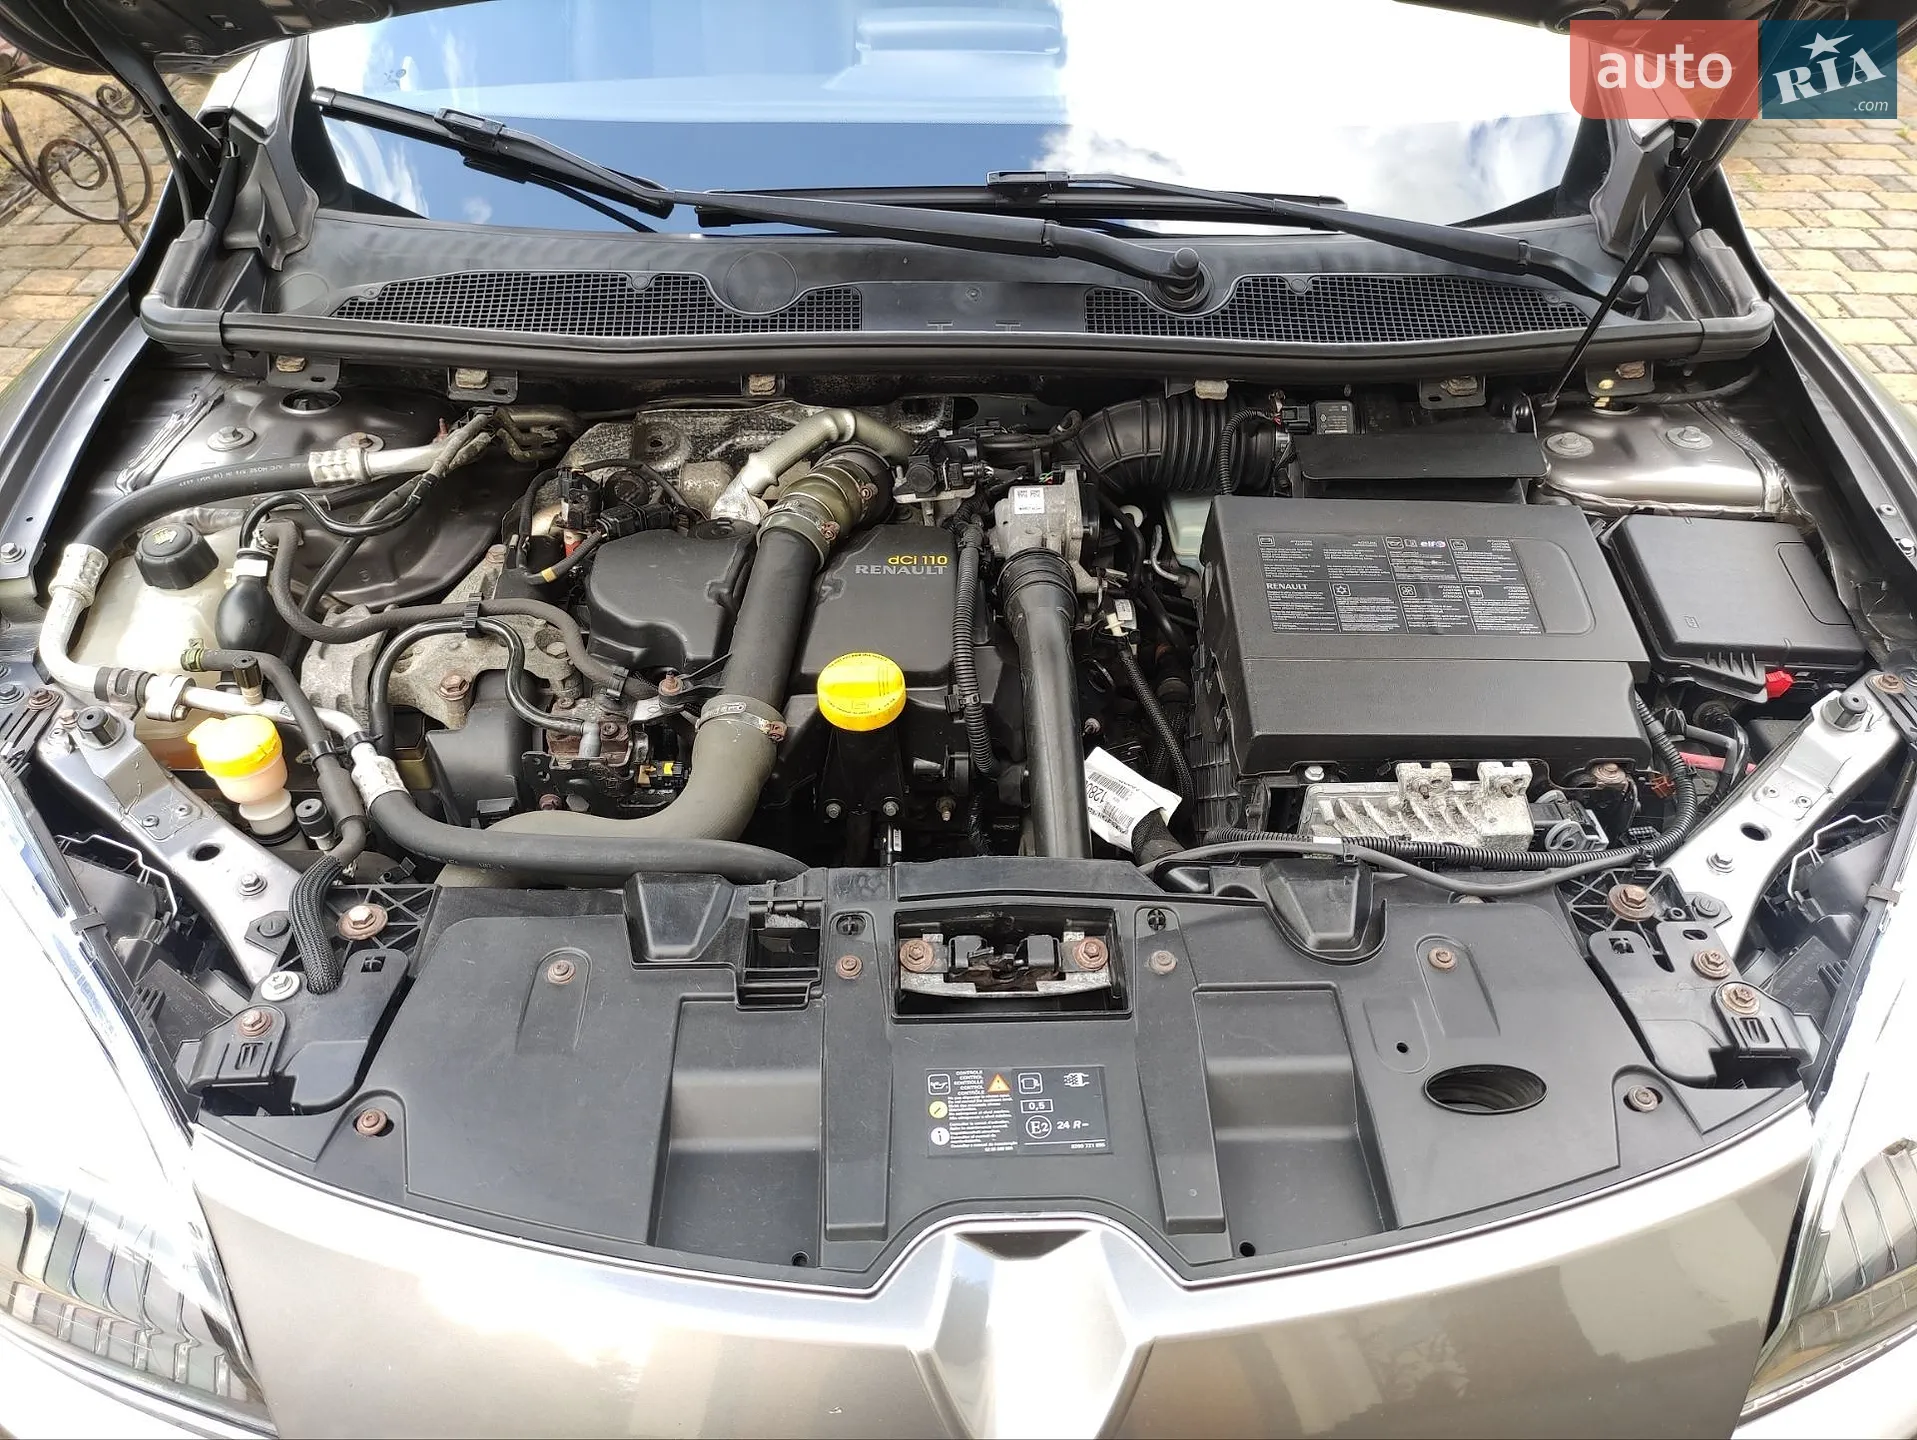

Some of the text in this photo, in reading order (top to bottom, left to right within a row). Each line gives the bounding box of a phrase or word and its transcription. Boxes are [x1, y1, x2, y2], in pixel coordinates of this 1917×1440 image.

[888, 555, 948, 565] dCi 110
[855, 564, 948, 575] RENAULT
[1028, 1102, 1046, 1111] 0,5
[1030, 1120, 1050, 1134] E2
[1056, 1121, 1071, 1130] 24
